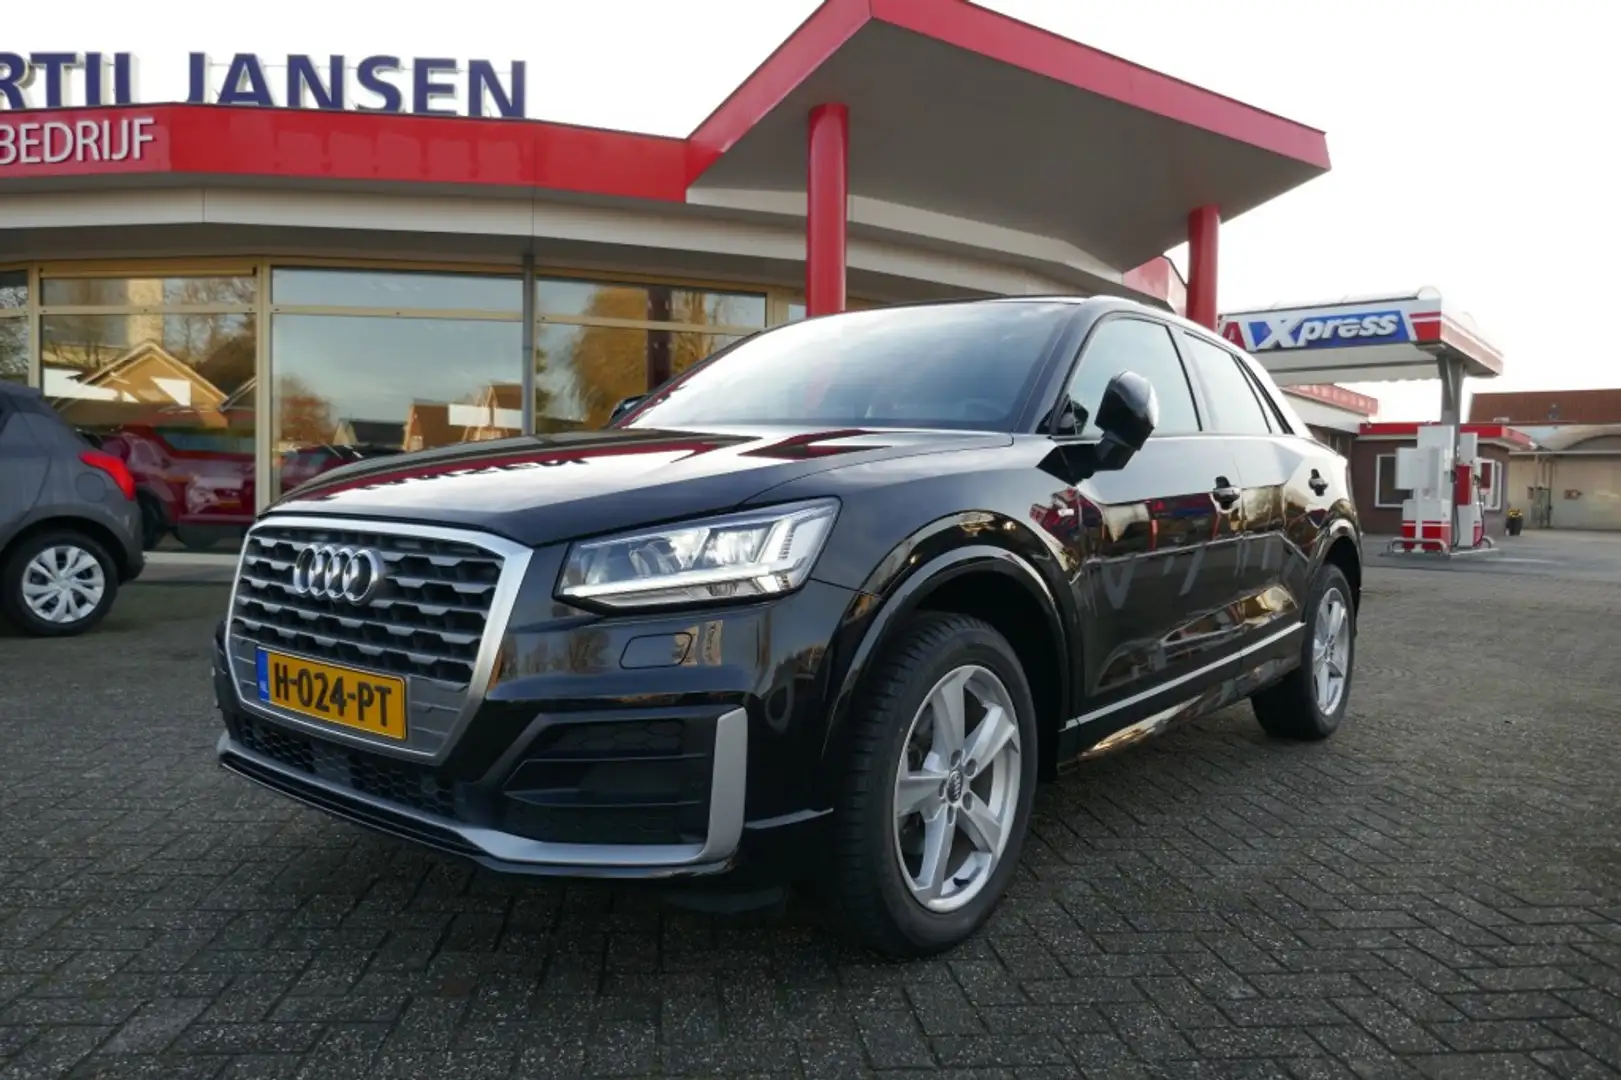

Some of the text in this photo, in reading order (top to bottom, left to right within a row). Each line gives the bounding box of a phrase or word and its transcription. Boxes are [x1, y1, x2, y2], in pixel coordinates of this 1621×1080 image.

[183, 52, 526, 118] JANSEN
[0, 116, 154, 165] BEDRIJF
[274, 662, 392, 727] H-024-PT
